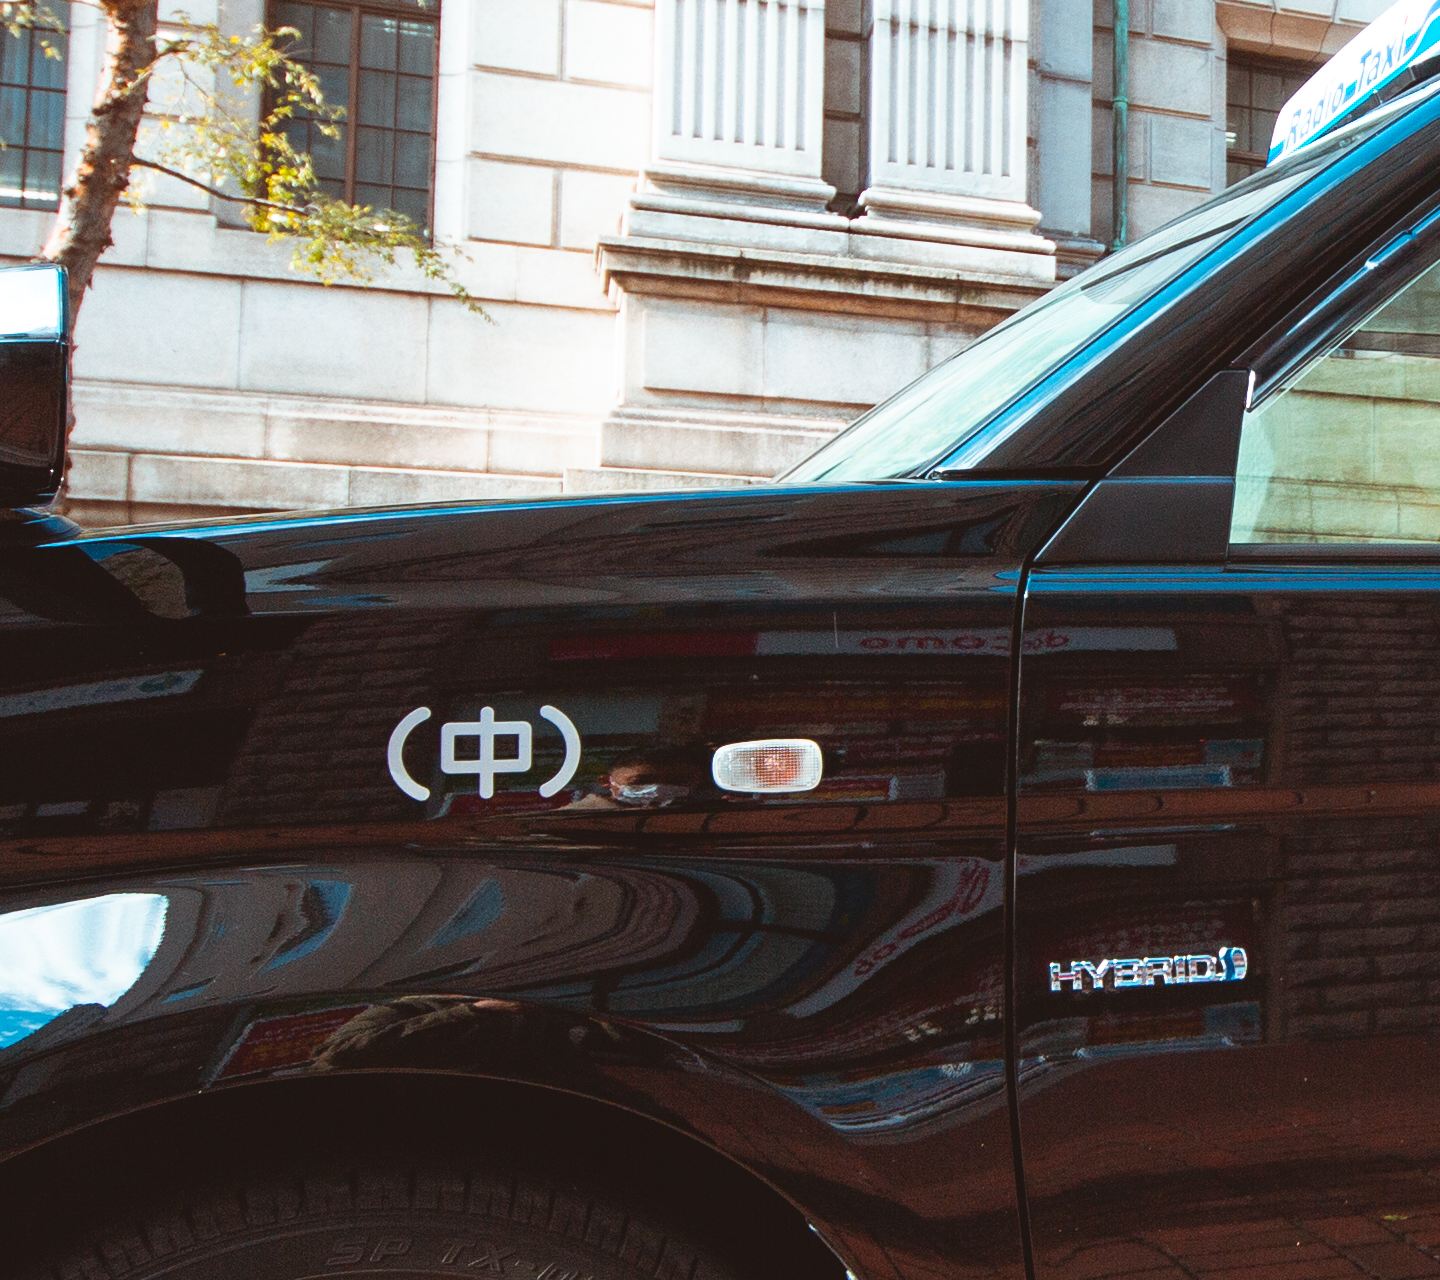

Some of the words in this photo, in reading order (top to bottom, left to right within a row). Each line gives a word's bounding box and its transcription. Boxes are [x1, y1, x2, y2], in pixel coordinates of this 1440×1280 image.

[1285, 78, 1344, 151] Radio
[1357, 16, 1408, 92] Taxi
[1049, 954, 1217, 992] HYBRID
